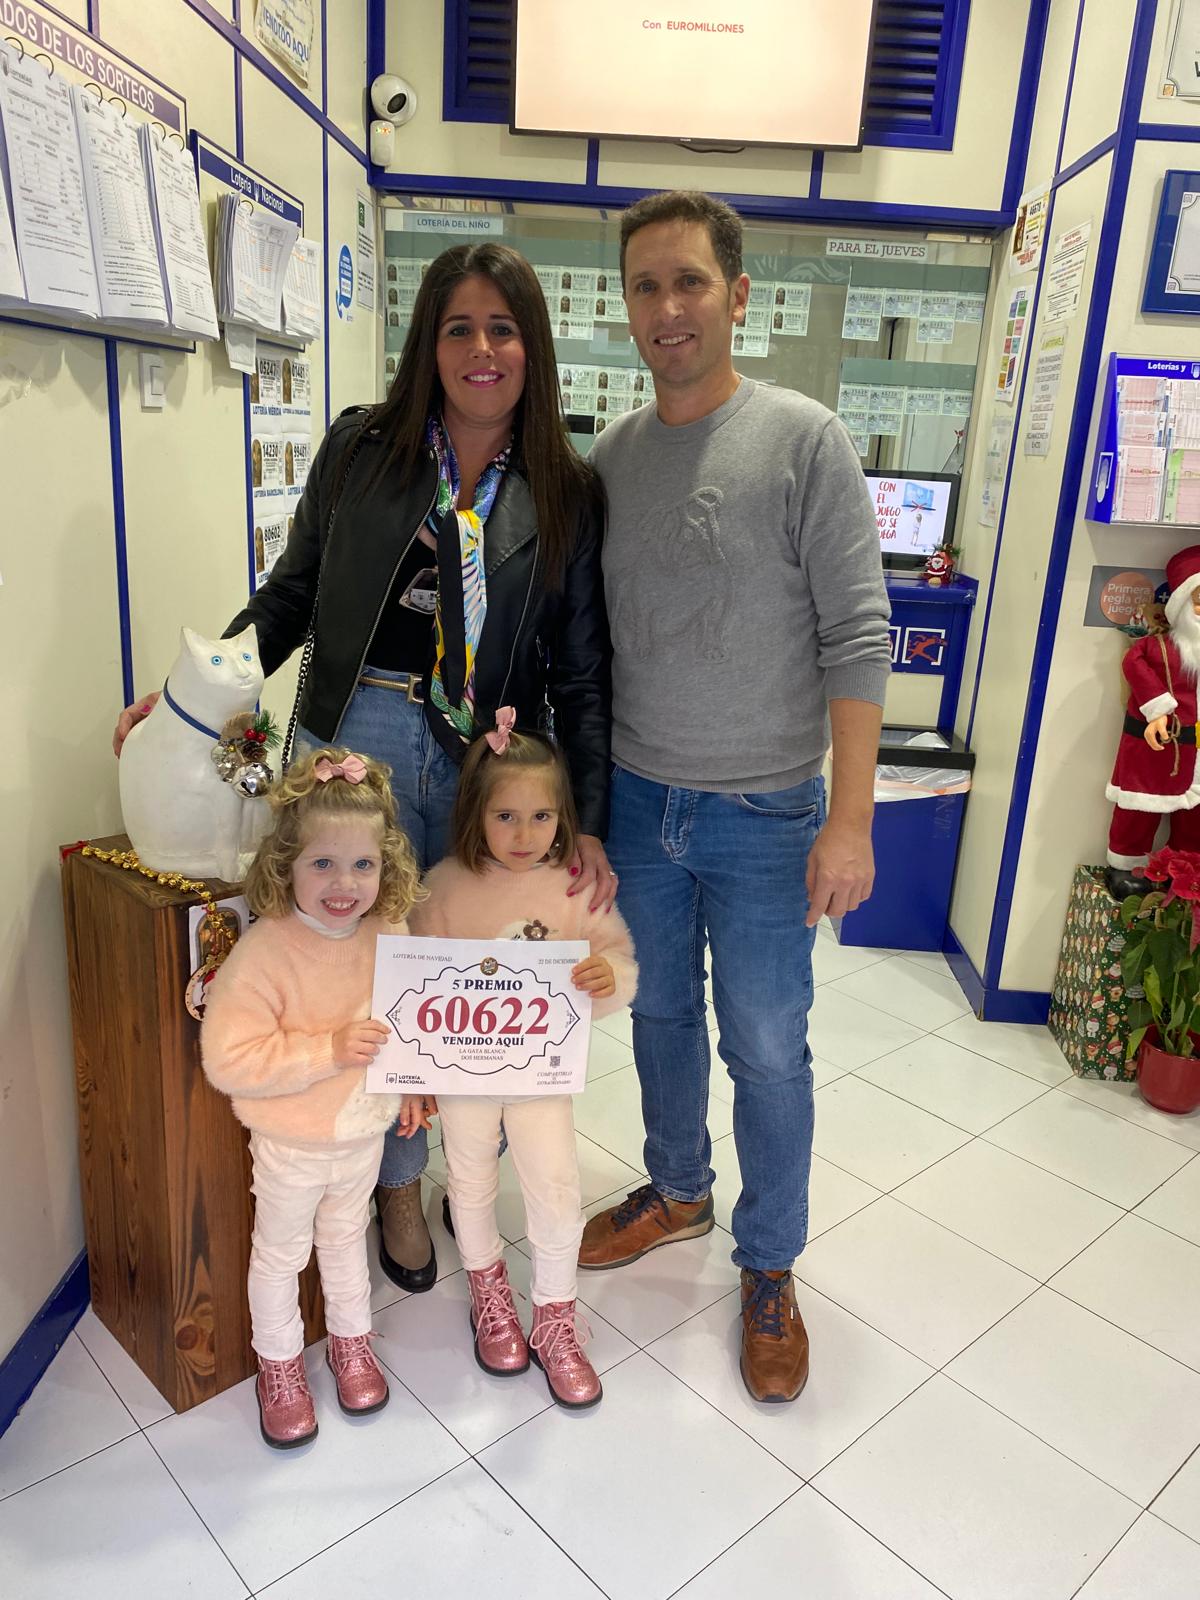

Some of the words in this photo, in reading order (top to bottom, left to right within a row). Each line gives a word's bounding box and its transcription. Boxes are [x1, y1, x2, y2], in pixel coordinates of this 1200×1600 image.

[642, 20, 661, 29] Con
[666, 20, 745, 34] EUROMILLONES
[0, 0, 37, 41] DOS
[42, 22, 63, 57] DE
[66, 37, 94, 76] LOS
[98, 59, 155, 114] SORTEOS
[230, 167, 252, 194] Lotería
[261, 186, 284, 214] Nacional
[417, 218, 450, 227] LOTERÍA
[451, 220, 467, 228] DEL
[468, 220, 491, 229] NIÑO
[829, 241, 861, 254] PARA
[864, 243, 880, 255] EL
[881, 245, 926, 258] JUEVES
[1147, 362, 1180, 371] Loterías
[1180, 364, 1187, 373] y
[879, 481, 896, 492] CON
[876, 506, 901, 517] JUEGO
[1108, 583, 1150, 594] Primera
[1104, 594, 1131, 605] regla
[1107, 604, 1135, 615] jueg
[464, 979, 523, 991] PREMIO
[416, 995, 550, 1035] 60622
[442, 1036, 493, 1046] VENDIDO
[495, 1034, 525, 1047] AQUÍ
